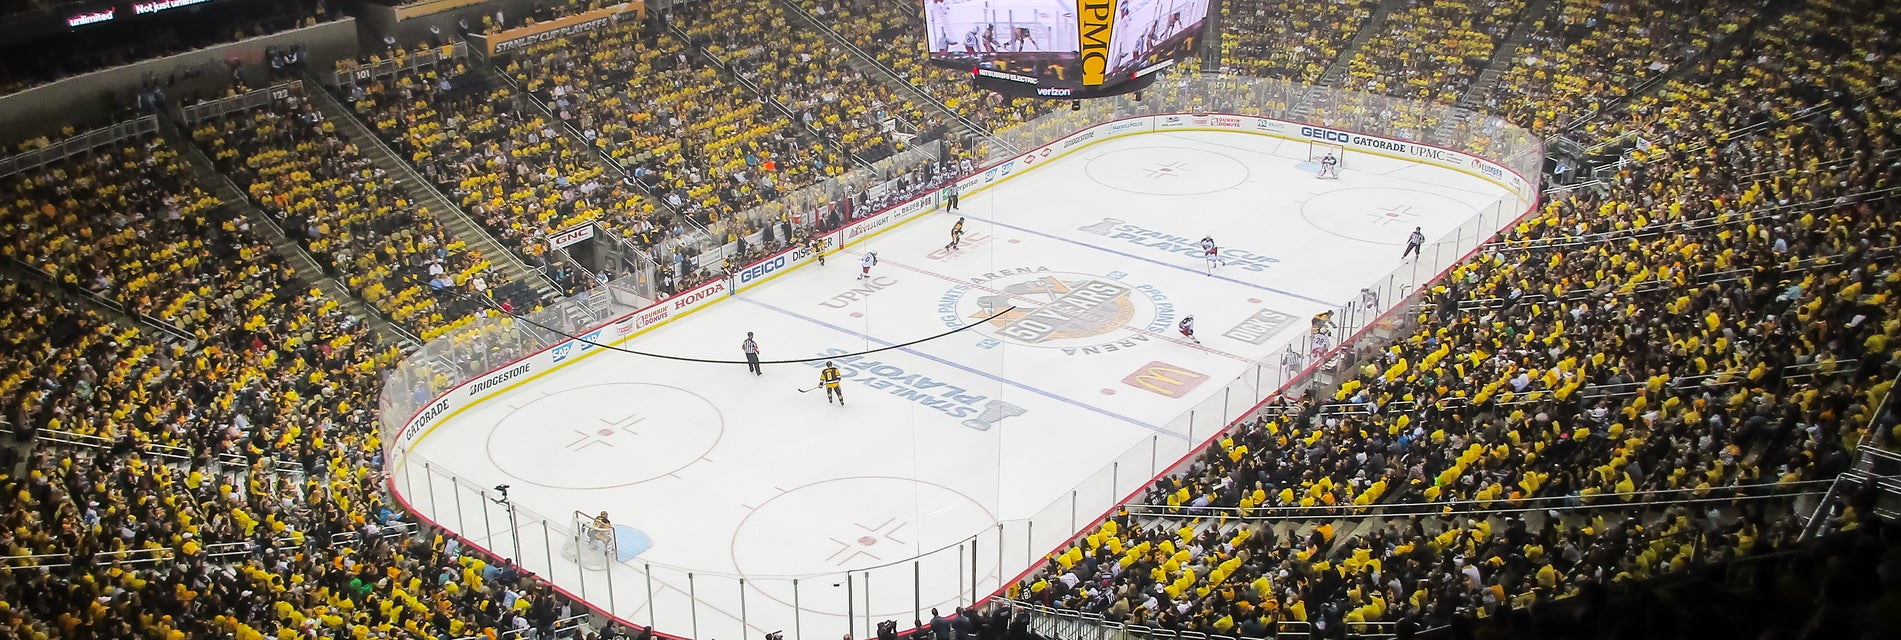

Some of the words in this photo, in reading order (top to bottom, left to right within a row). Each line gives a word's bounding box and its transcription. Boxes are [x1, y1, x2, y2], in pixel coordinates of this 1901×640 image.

[135, 4, 153, 14] Not
[153, 1, 171, 13] just
[69, 11, 113, 26] unlimited
[495, 34, 539, 52] STANLEY
[562, 17, 608, 35] PLAYOFFS
[1083, 0, 1109, 75] PMC
[356, 70, 370, 80] 101
[272, 89, 288, 100] 122
[1037, 86, 1070, 96] verizon
[1301, 126, 1350, 143] GEICO
[1353, 136, 1406, 153] GATORADE
[1410, 145, 1445, 161] UPMC
[872, 216, 890, 229] LIGHT
[555, 228, 589, 246] GNC
[1112, 223, 1224, 250] STANLE
[1222, 249, 1280, 263] CUP
[1110, 232, 1270, 272] PLAYOFS
[741, 256, 785, 284] GEICO
[971, 265, 1050, 285] ARENA
[674, 283, 725, 311] HONDA
[819, 276, 898, 309] UPMC
[1137, 284, 1168, 301] PPG
[644, 306, 669, 320] DUNKIN'
[644, 312, 668, 326] DONUTS
[1004, 319, 1054, 341] 50
[1038, 283, 1122, 321] YEARS
[1147, 302, 1175, 334] PAINTS
[1061, 334, 1150, 356] ARENA
[469, 362, 530, 396] BRIDGESTONE
[853, 376, 978, 418] STANLEY
[405, 398, 450, 442] GATORADE
